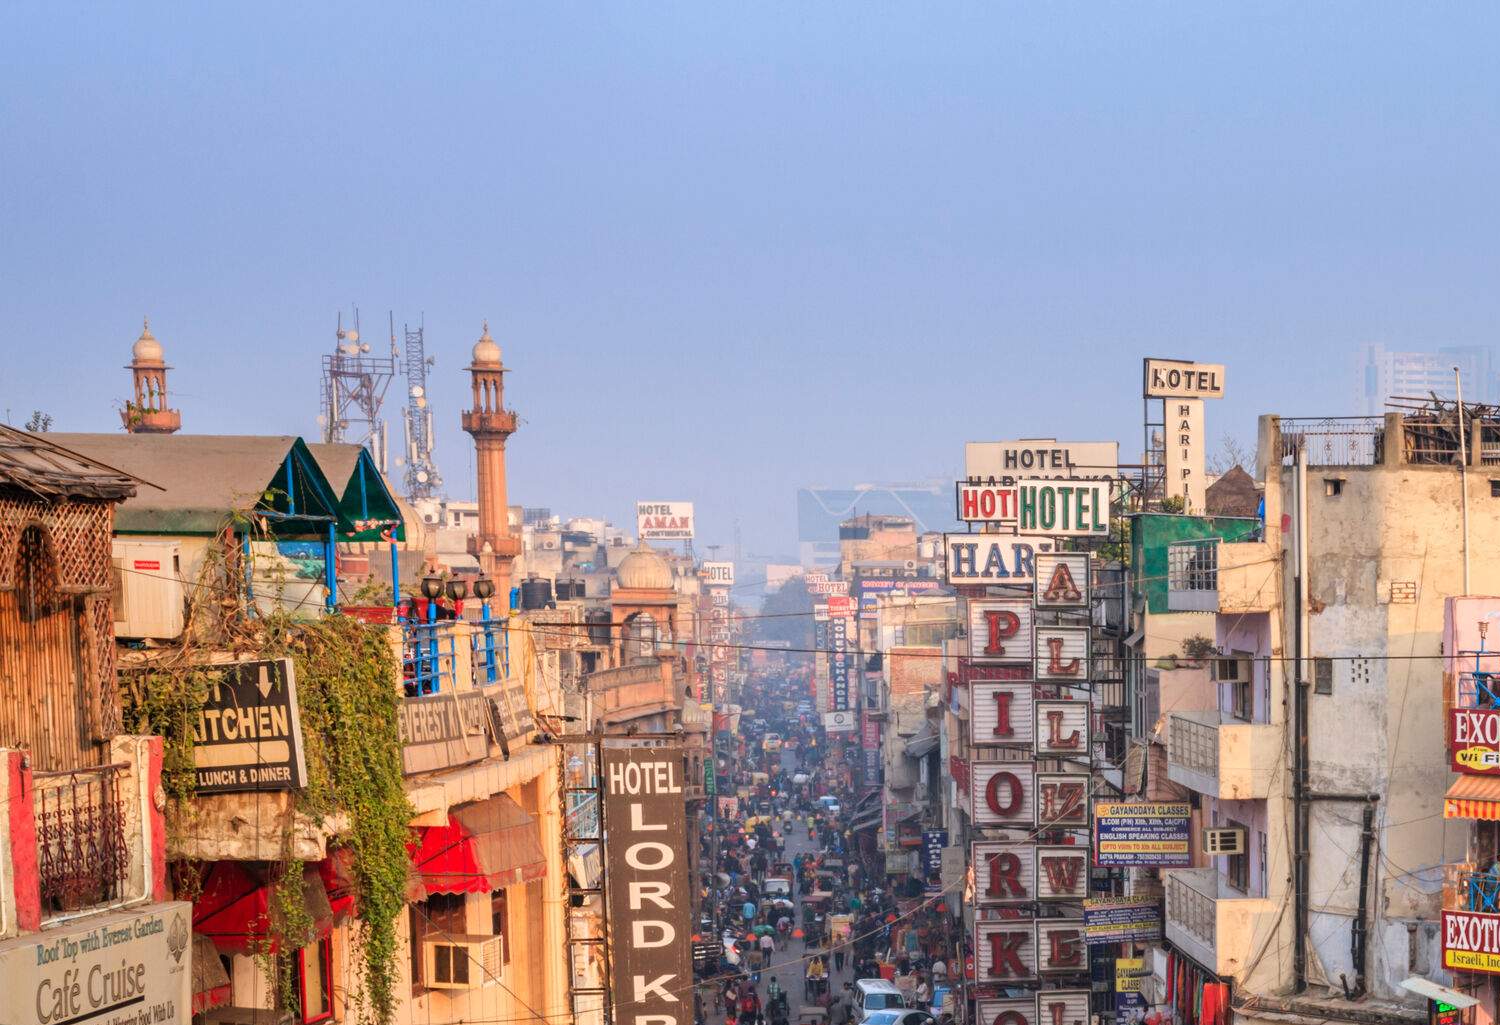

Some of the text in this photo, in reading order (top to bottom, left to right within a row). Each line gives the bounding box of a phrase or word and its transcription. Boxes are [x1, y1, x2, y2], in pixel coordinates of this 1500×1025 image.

[1152, 369, 1220, 391] HOTEL
[1180, 405, 1190, 459] HARI
[1005, 450, 1076, 469] HOTEL
[639, 505, 672, 515] HOTEL
[1020, 486, 1107, 532] HOTEL
[643, 517, 689, 528] AMAN
[704, 567, 732, 580] HOTEL
[818, 584, 847, 593] HOTEL
[836, 661, 846, 710] CHANGER
[200, 767, 291, 786] LUNCH & DINNER
[609, 762, 682, 795] HOTEL
[1110, 806, 1189, 816] GAYANODAYA CLASSES
[624, 803, 676, 949] LORD
[37, 917, 164, 966] Roof Top with Everest Garden
[1452, 951, 1484, 969] Israeli,
[36, 959, 146, 1025] Café Cruise
[153, 1004, 166, 1022] With
